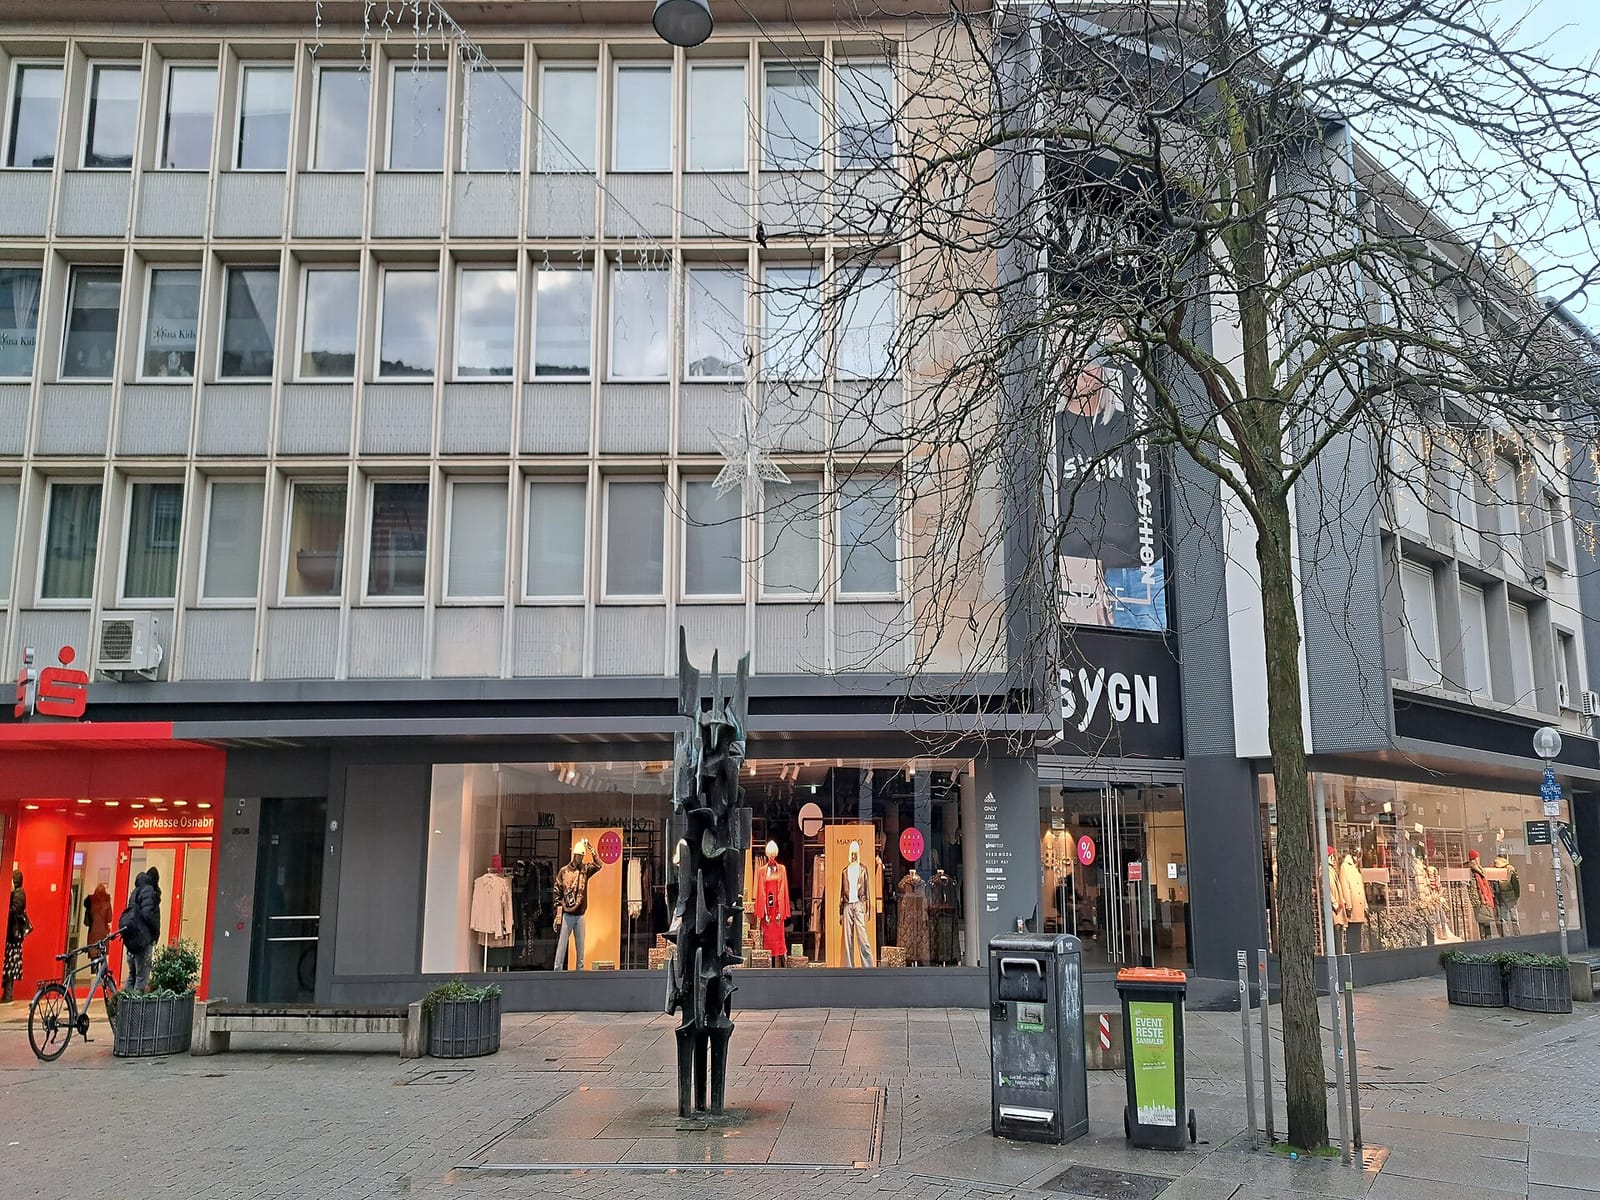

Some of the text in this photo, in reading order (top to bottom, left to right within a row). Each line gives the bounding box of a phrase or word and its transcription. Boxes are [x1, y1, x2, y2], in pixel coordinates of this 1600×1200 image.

[1136, 462, 1156, 585] FASHION
[132, 815, 214, 830] Sparkasse Osnabr
[1135, 1017, 1163, 1027] EVENT
[1136, 1027, 1164, 1038] RESTE
[1136, 1037, 1164, 1046] SAMMLER
